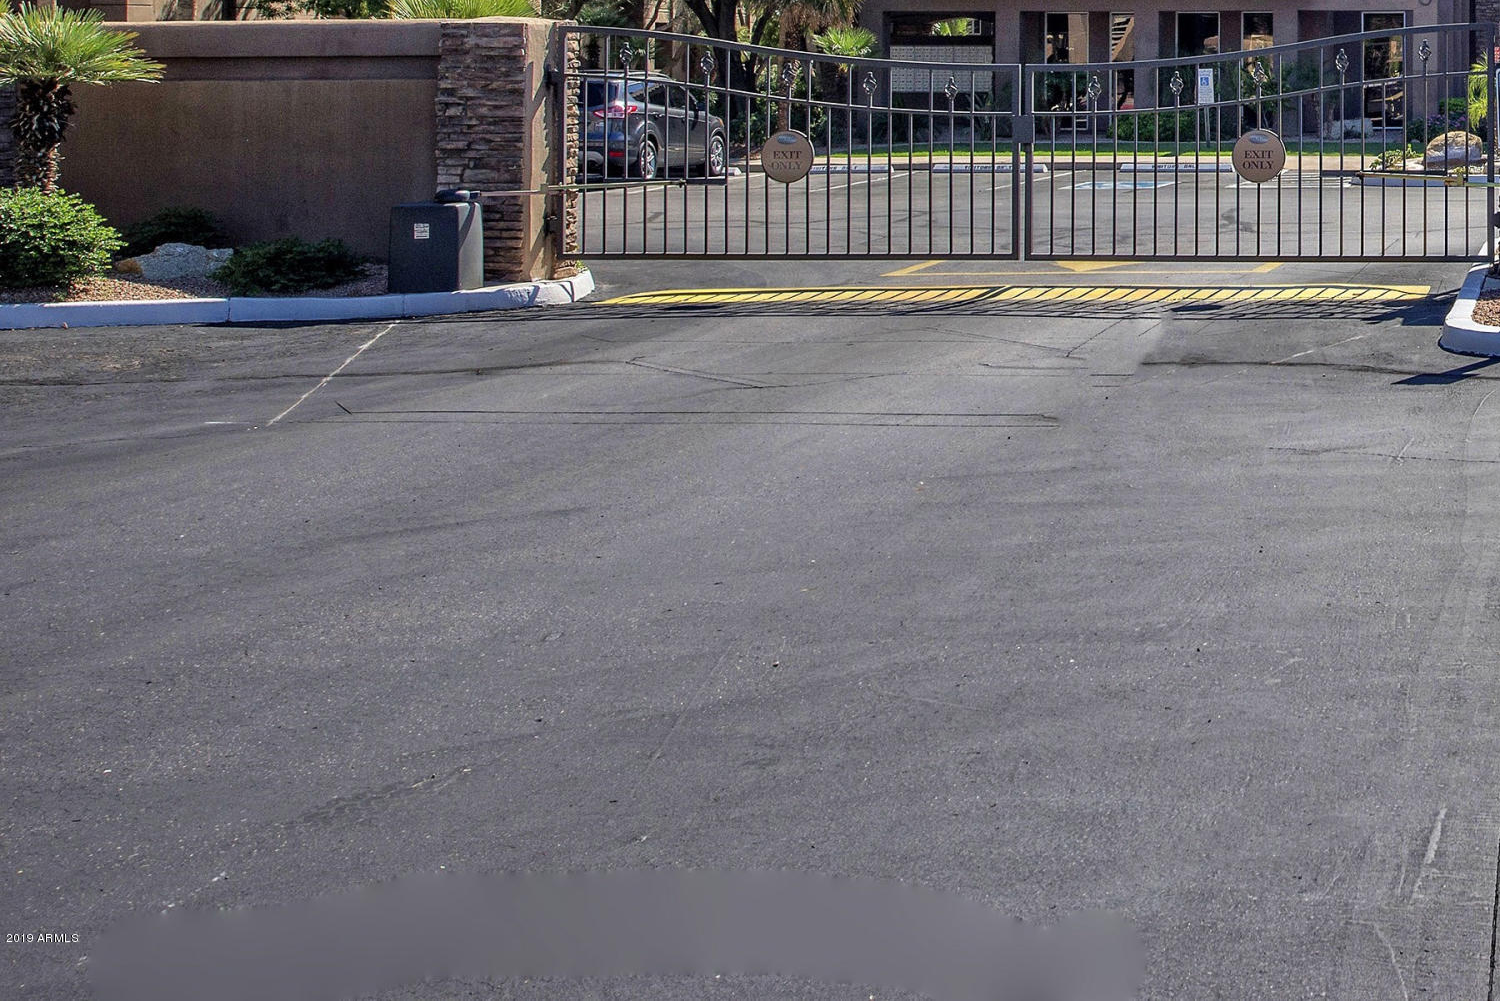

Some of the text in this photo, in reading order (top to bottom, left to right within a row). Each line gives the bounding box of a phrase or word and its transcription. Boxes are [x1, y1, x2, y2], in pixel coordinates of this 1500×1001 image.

[773, 150, 802, 159] EXIT
[1244, 150, 1274, 159] EXIT
[771, 160, 803, 170] ONLY
[1242, 160, 1274, 170] ONLY
